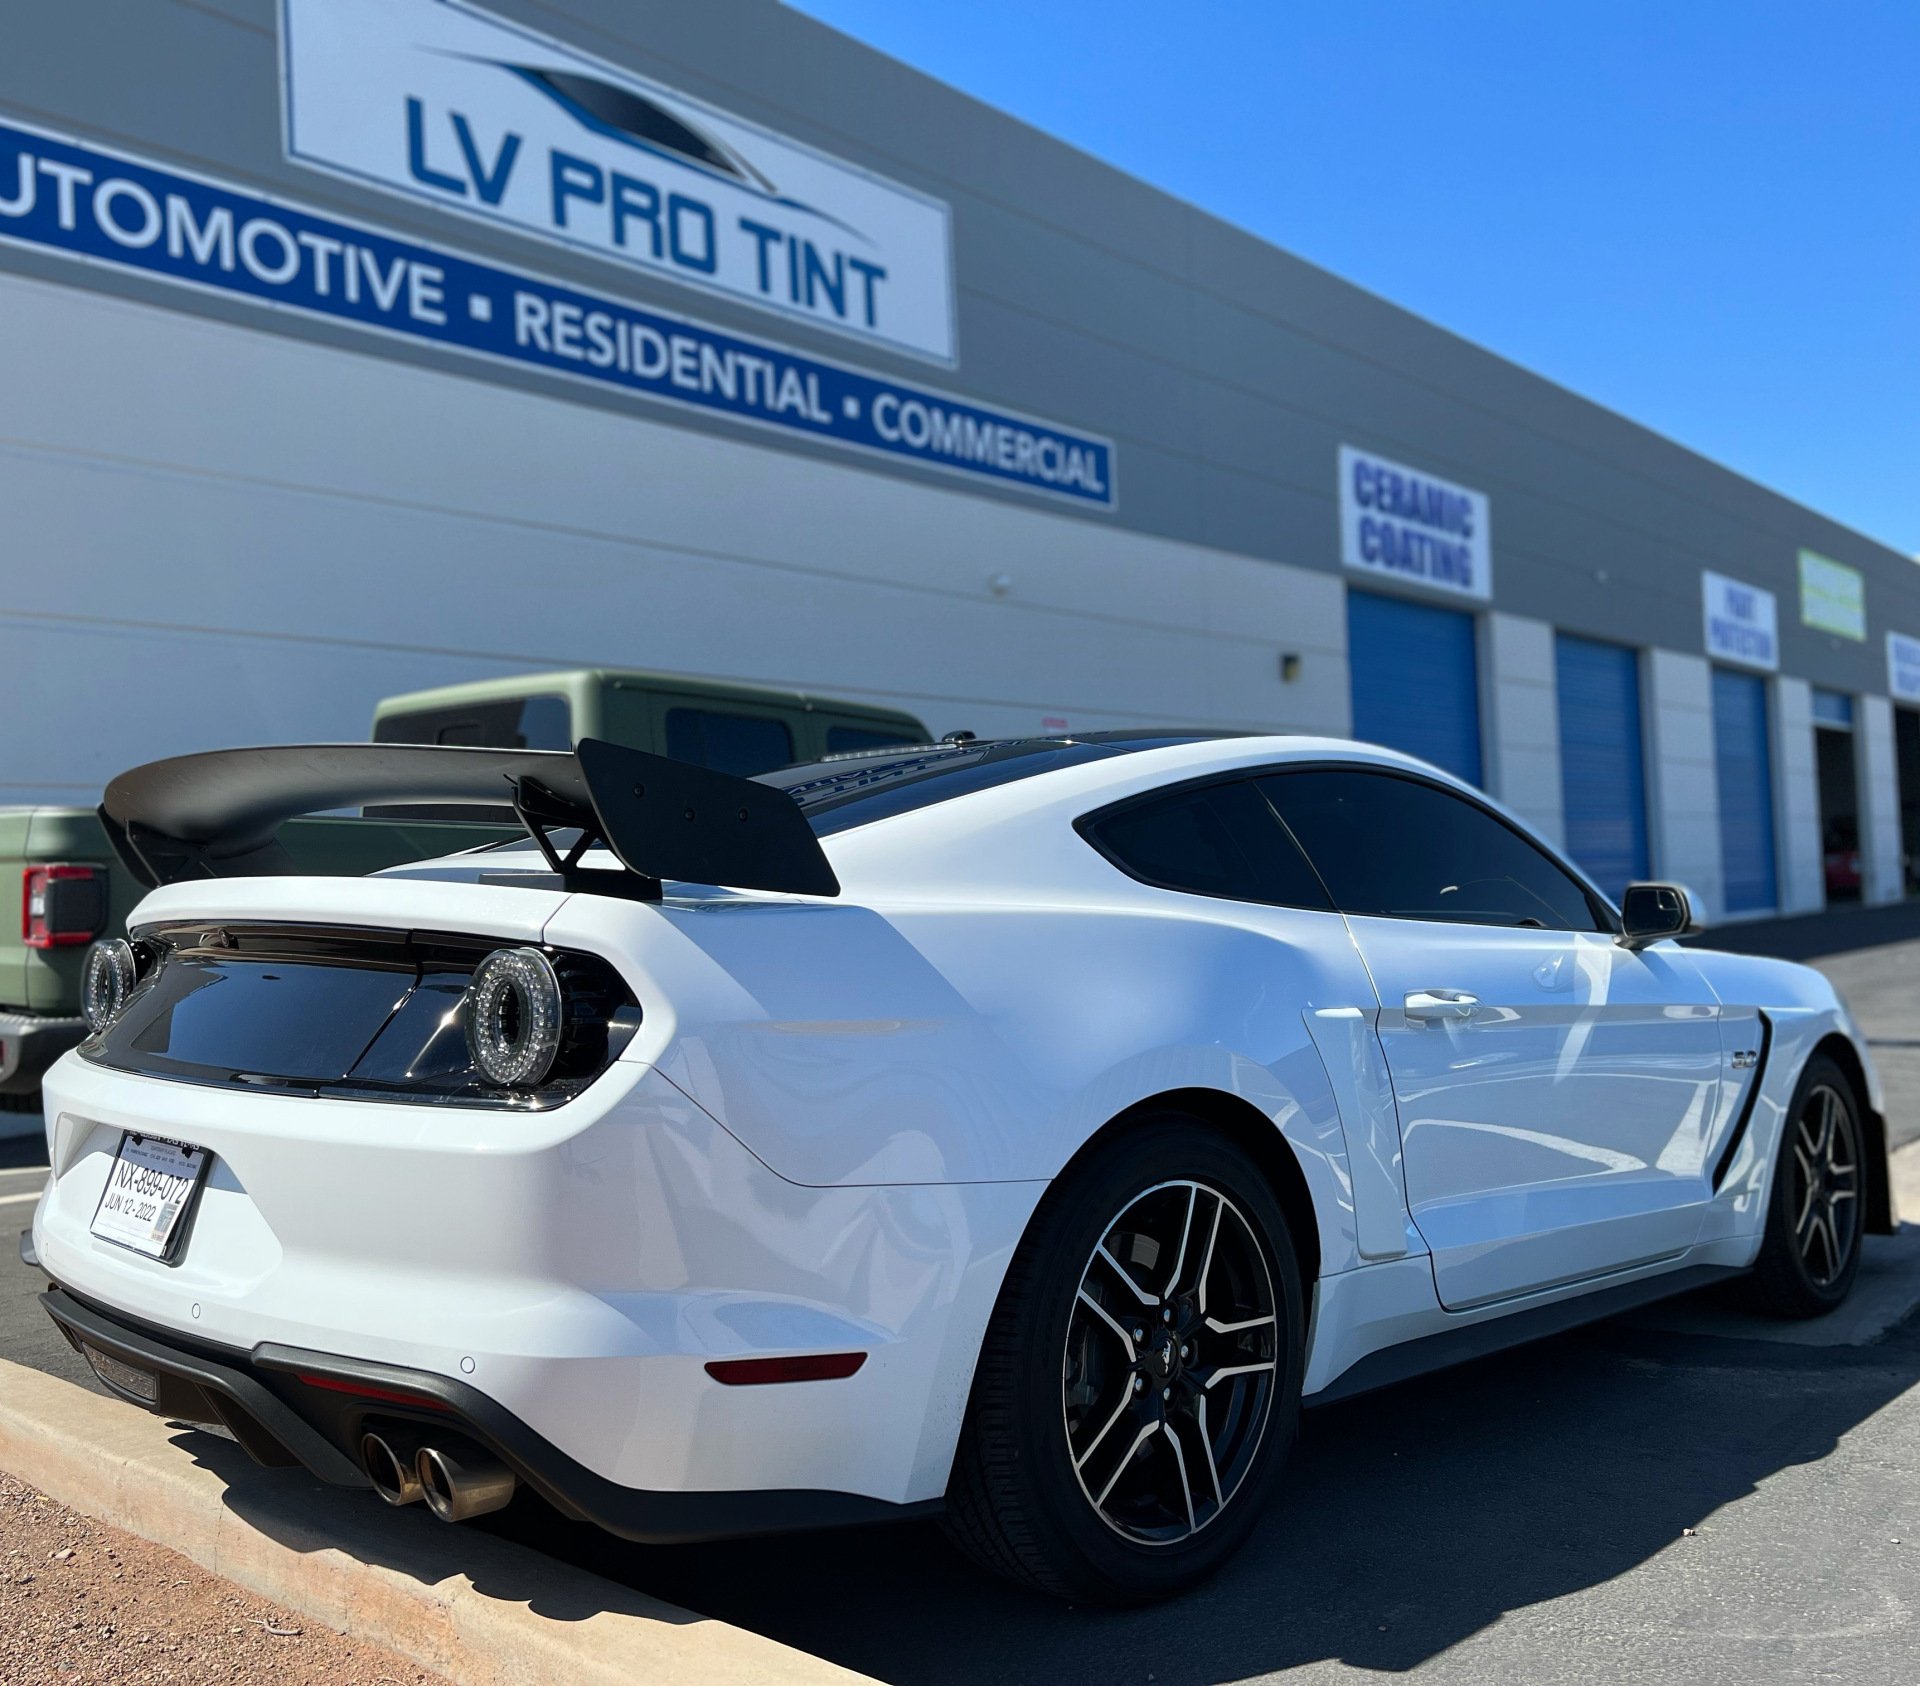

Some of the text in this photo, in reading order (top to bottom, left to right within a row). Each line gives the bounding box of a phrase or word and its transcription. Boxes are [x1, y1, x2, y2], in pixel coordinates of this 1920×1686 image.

[404, 95, 888, 329] LV PRO TINT
[513, 291, 832, 425] RESIDENTIAL
[871, 392, 1105, 493] COMMERCIAL
[1353, 459, 1474, 539] CERAMIC
[1358, 516, 1473, 588] COATING
[104, 1192, 122, 1212] JUN
[134, 1201, 157, 1222] 2022
[114, 1162, 188, 1204] NX-899-072
